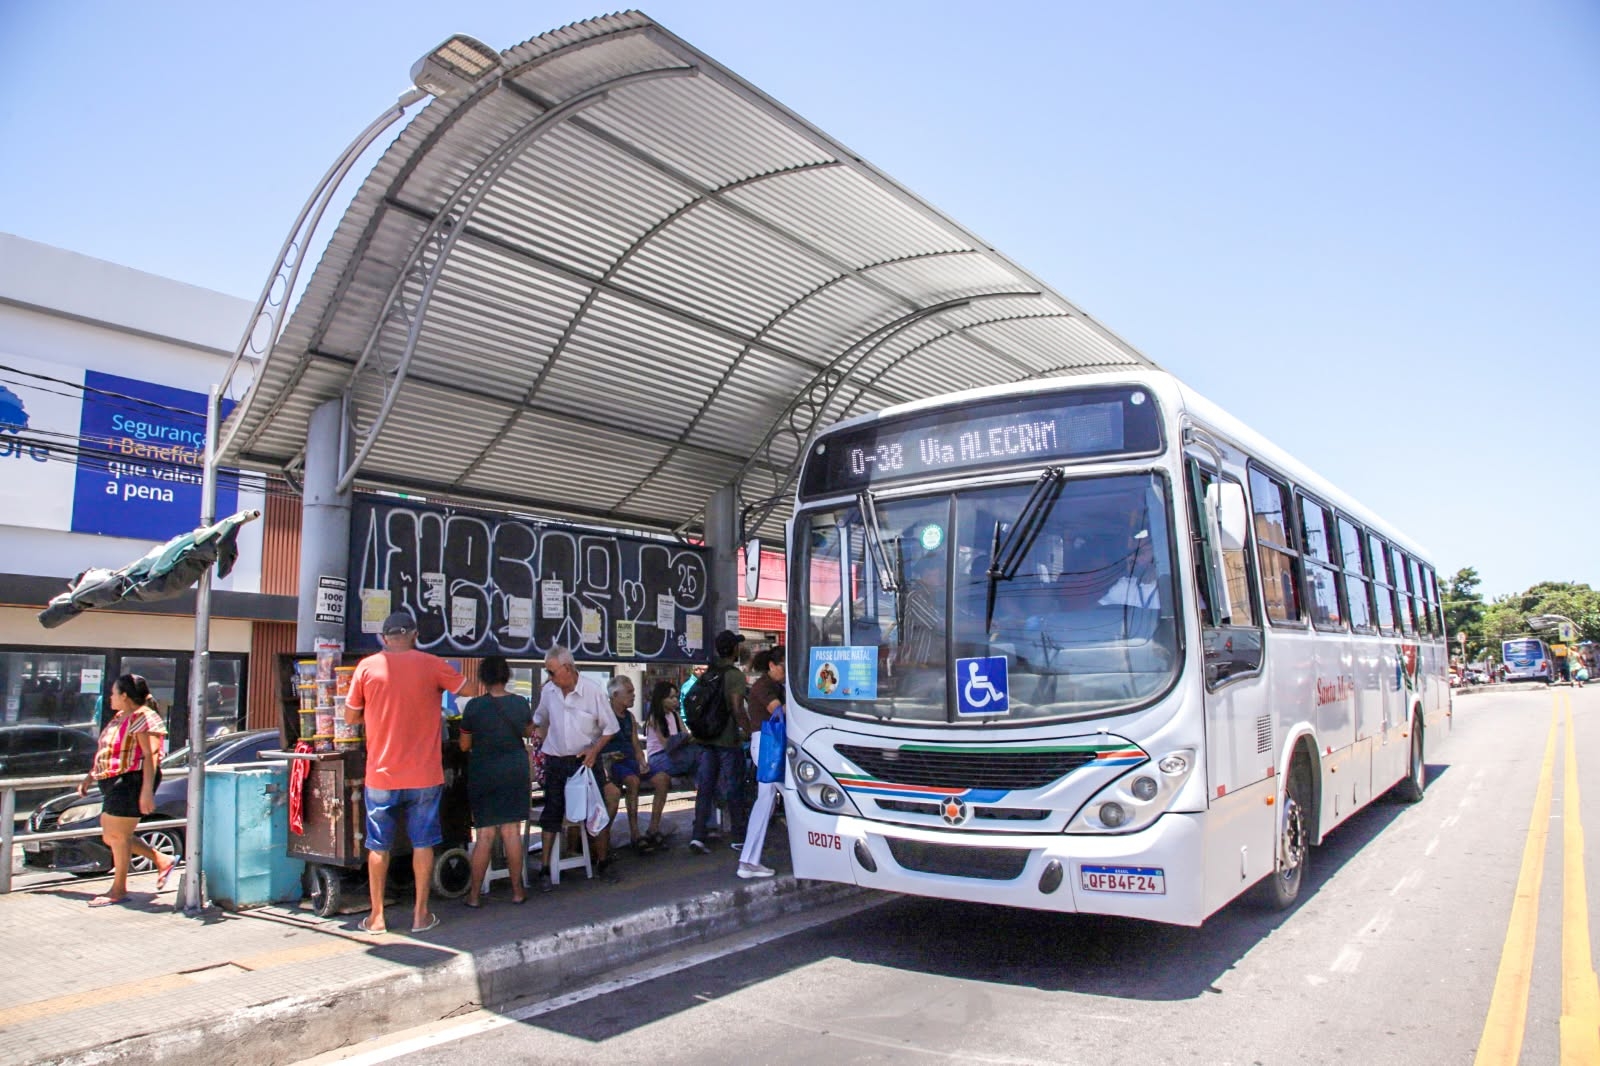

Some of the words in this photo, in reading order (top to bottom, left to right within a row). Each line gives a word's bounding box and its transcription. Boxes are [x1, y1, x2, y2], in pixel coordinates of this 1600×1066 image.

[959, 419, 1057, 461] ALECRIM
[107, 461, 147, 479] que
[105, 480, 118, 495] a
[123, 483, 174, 502] pena
[324, 592, 344, 602] 1000
[327, 602, 342, 613] 103
[815, 650, 833, 661] PASSE
[833, 650, 850, 661] LIVRE
[851, 649, 871, 661] NATAL
[807, 831, 842, 850] 02076
[1089, 873, 1156, 891] QFB4F24
